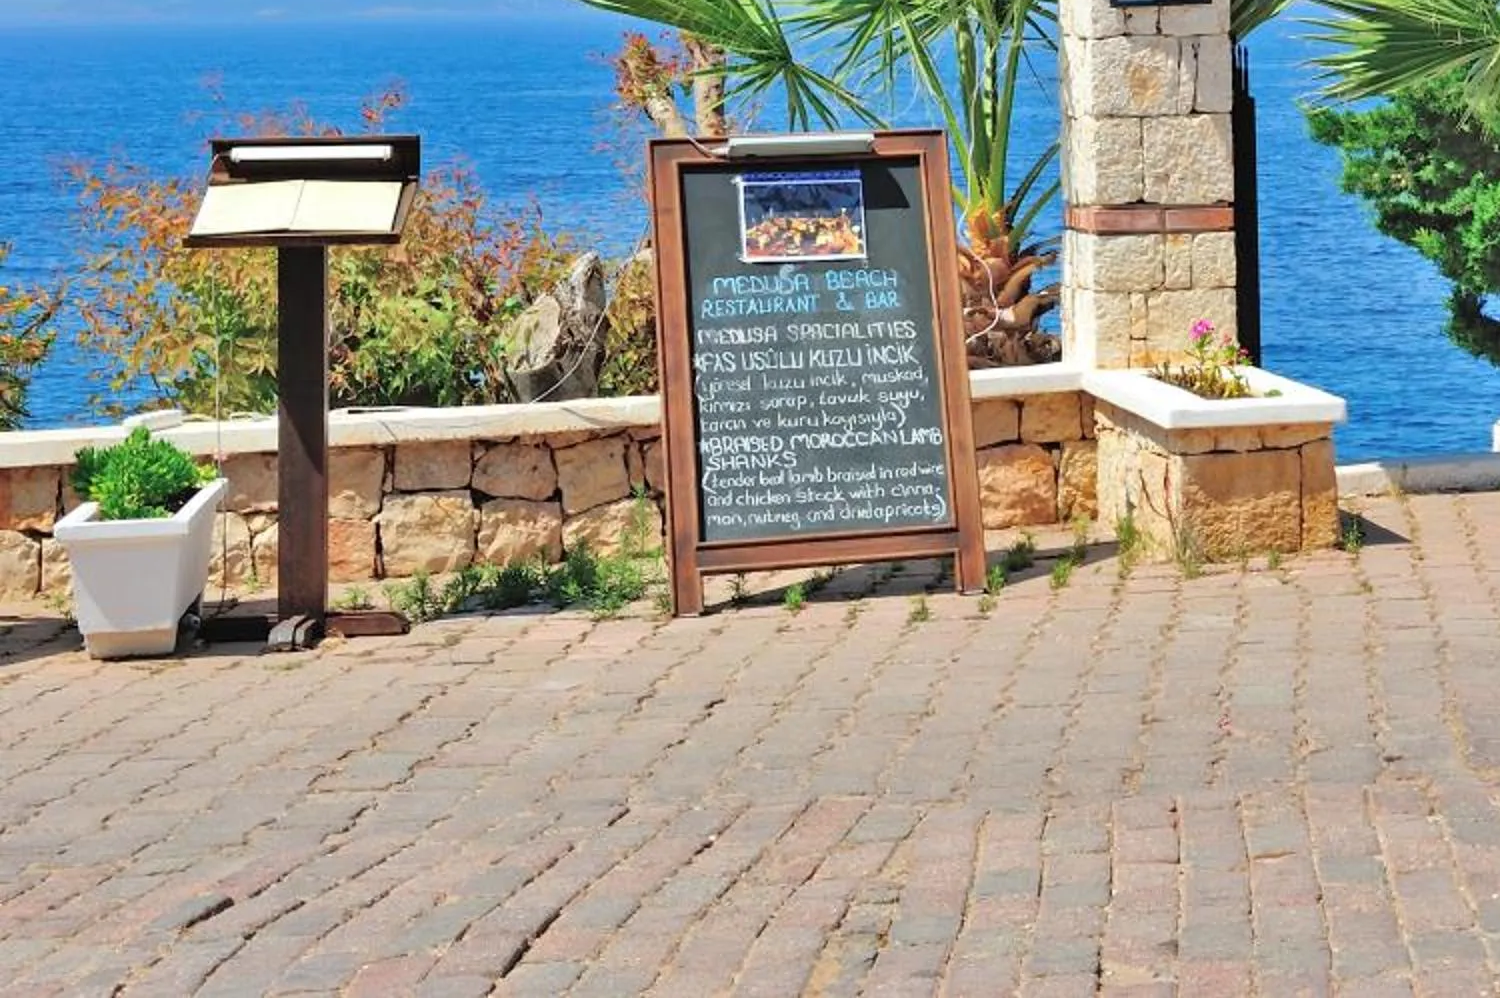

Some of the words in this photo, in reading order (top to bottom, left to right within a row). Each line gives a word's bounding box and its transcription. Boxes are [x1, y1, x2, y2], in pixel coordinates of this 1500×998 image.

[713, 273, 810, 296] MEDUSA
[825, 269, 899, 291] BEACH
[701, 293, 819, 319] RESTAURANT
[836, 291, 855, 312] &
[864, 290, 902, 309] BAR
[697, 324, 778, 345] MEDUSA
[809, 346, 863, 368] KUZU
[752, 417, 771, 429] ve
[777, 411, 819, 428] kuru
[789, 429, 898, 450] MOROCCAN
[900, 426, 944, 446] LAMB
[706, 449, 798, 471] SHANKS
[879, 466, 894, 480] in
[707, 489, 733, 507] and
[848, 482, 885, 499] with
